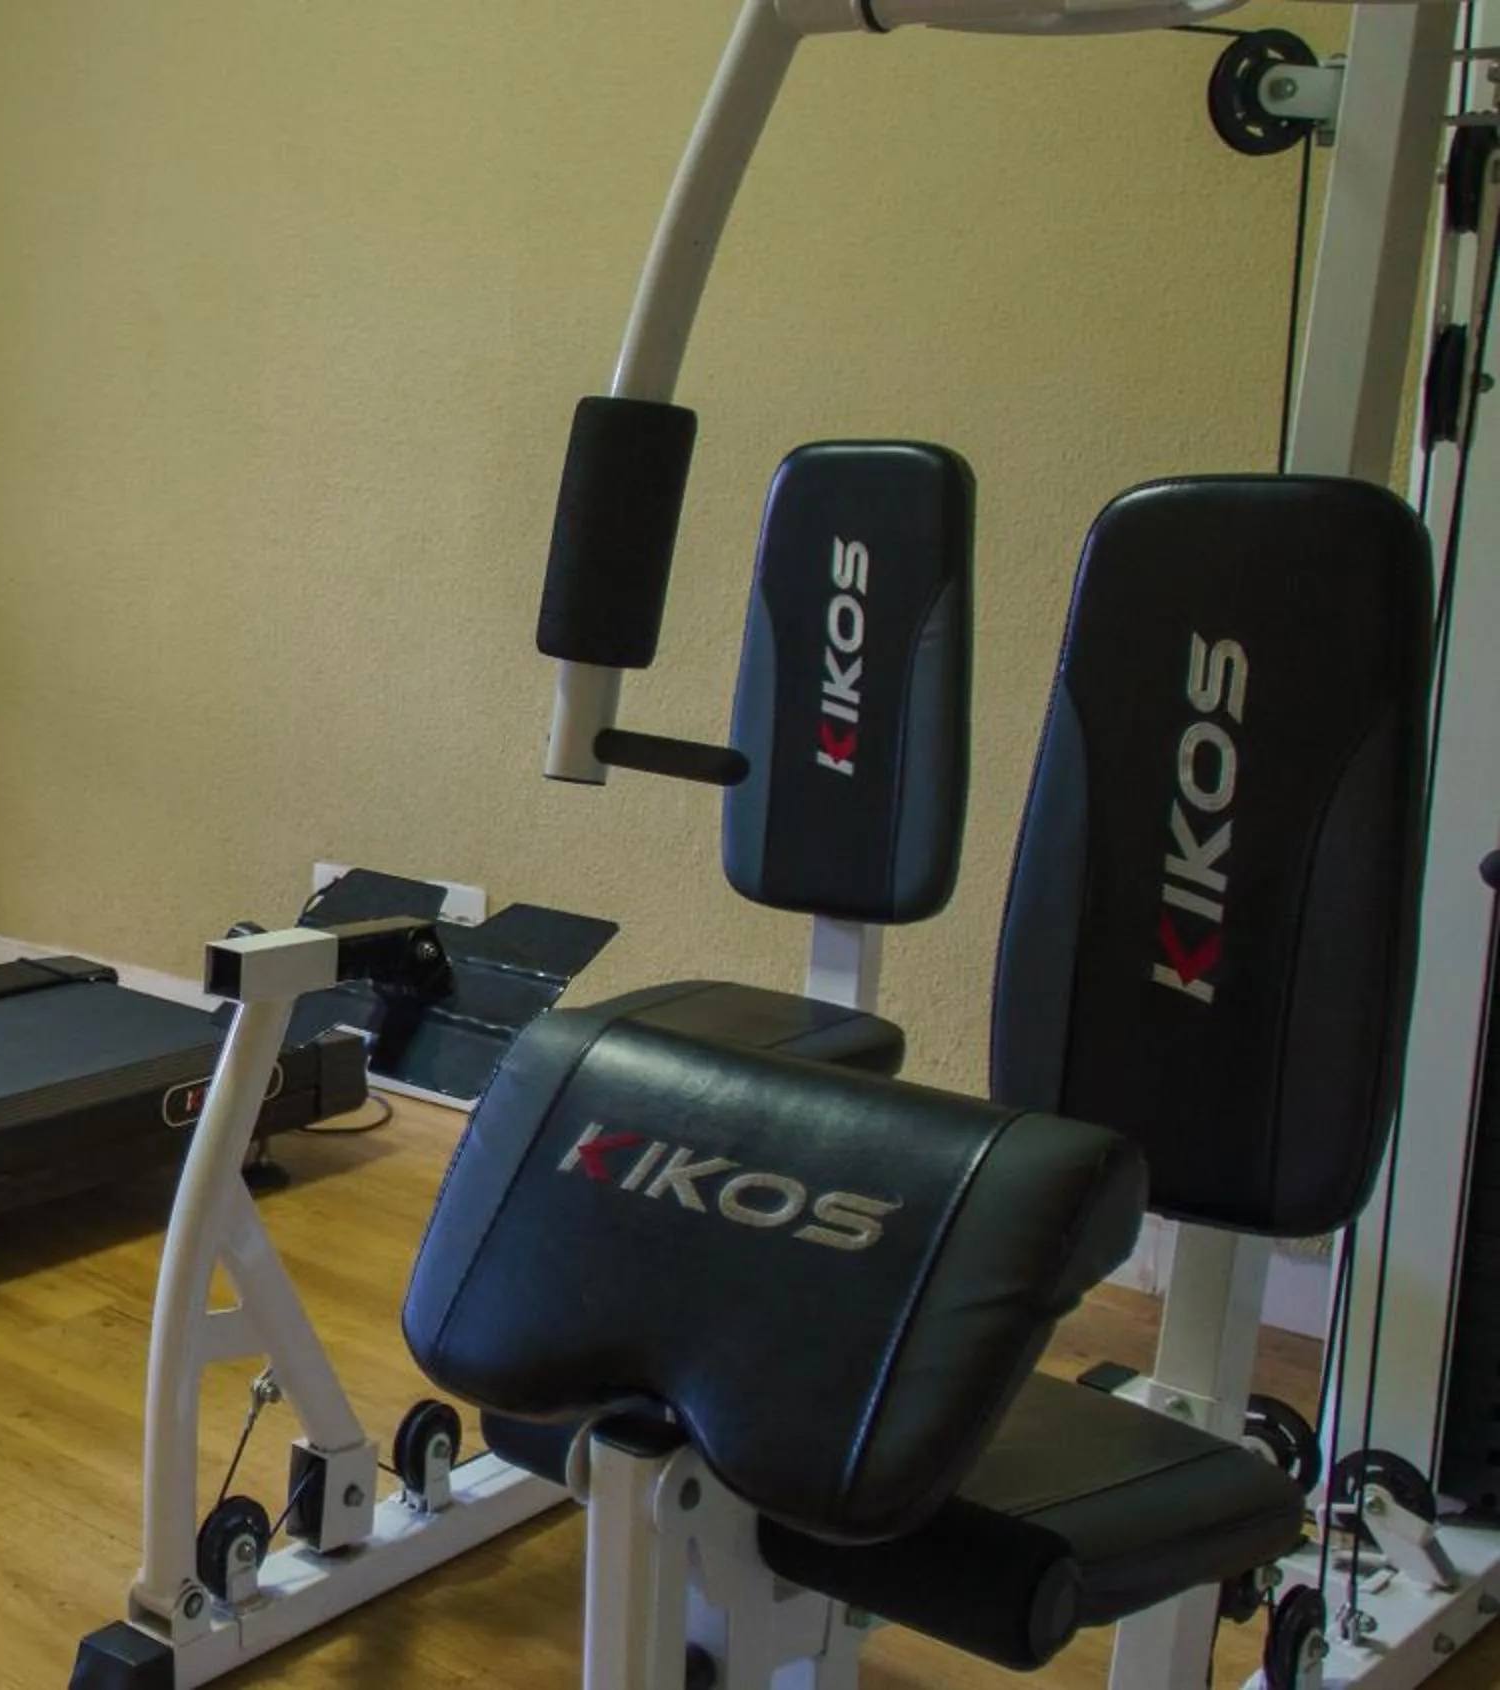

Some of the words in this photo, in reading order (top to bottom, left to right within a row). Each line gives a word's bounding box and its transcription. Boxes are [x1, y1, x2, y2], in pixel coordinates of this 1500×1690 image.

[817, 535, 869, 776] KIKOS
[1152, 631, 1249, 1004] KIKOS
[556, 1121, 904, 1250] KIKOS
